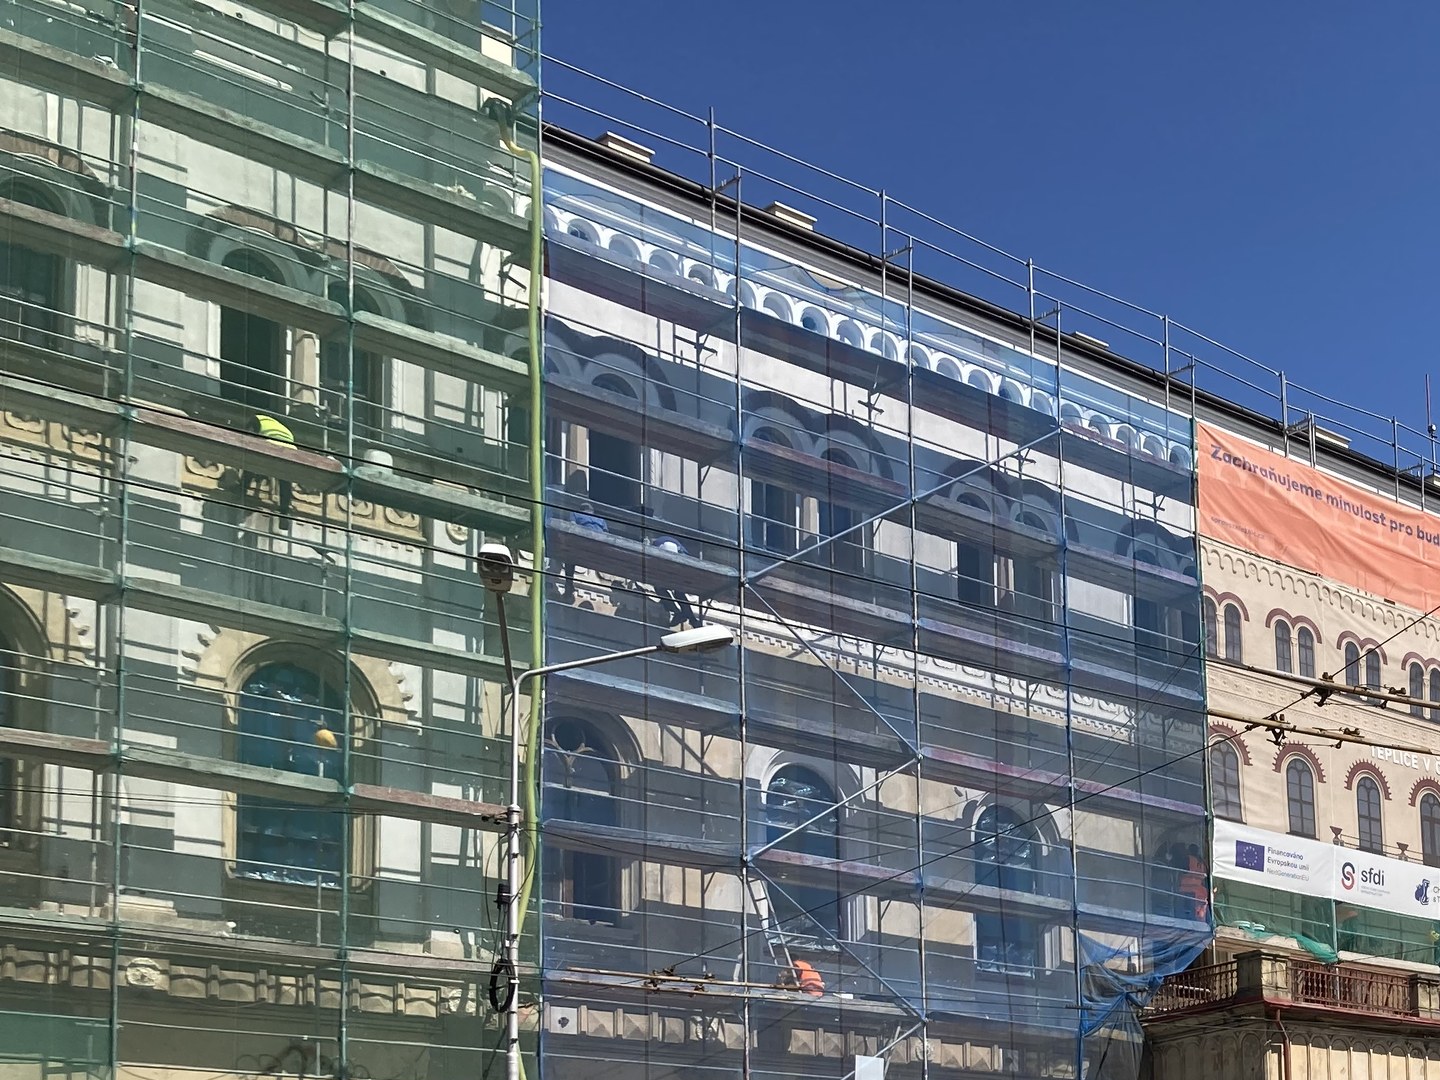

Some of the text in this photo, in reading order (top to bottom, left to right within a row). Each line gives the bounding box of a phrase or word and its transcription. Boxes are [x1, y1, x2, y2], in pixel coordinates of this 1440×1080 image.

[1210, 444, 1323, 501] Zachraňujeme
[1326, 494, 1387, 526] minulost
[1390, 518, 1413, 537] pro
[1370, 746, 1419, 770] TEPLICE
[1422, 757, 1431, 772] V
[1267, 846, 1304, 861] Financováno
[1267, 856, 1310, 871] Evropskou unii
[1360, 867, 1385, 887] sfdi
